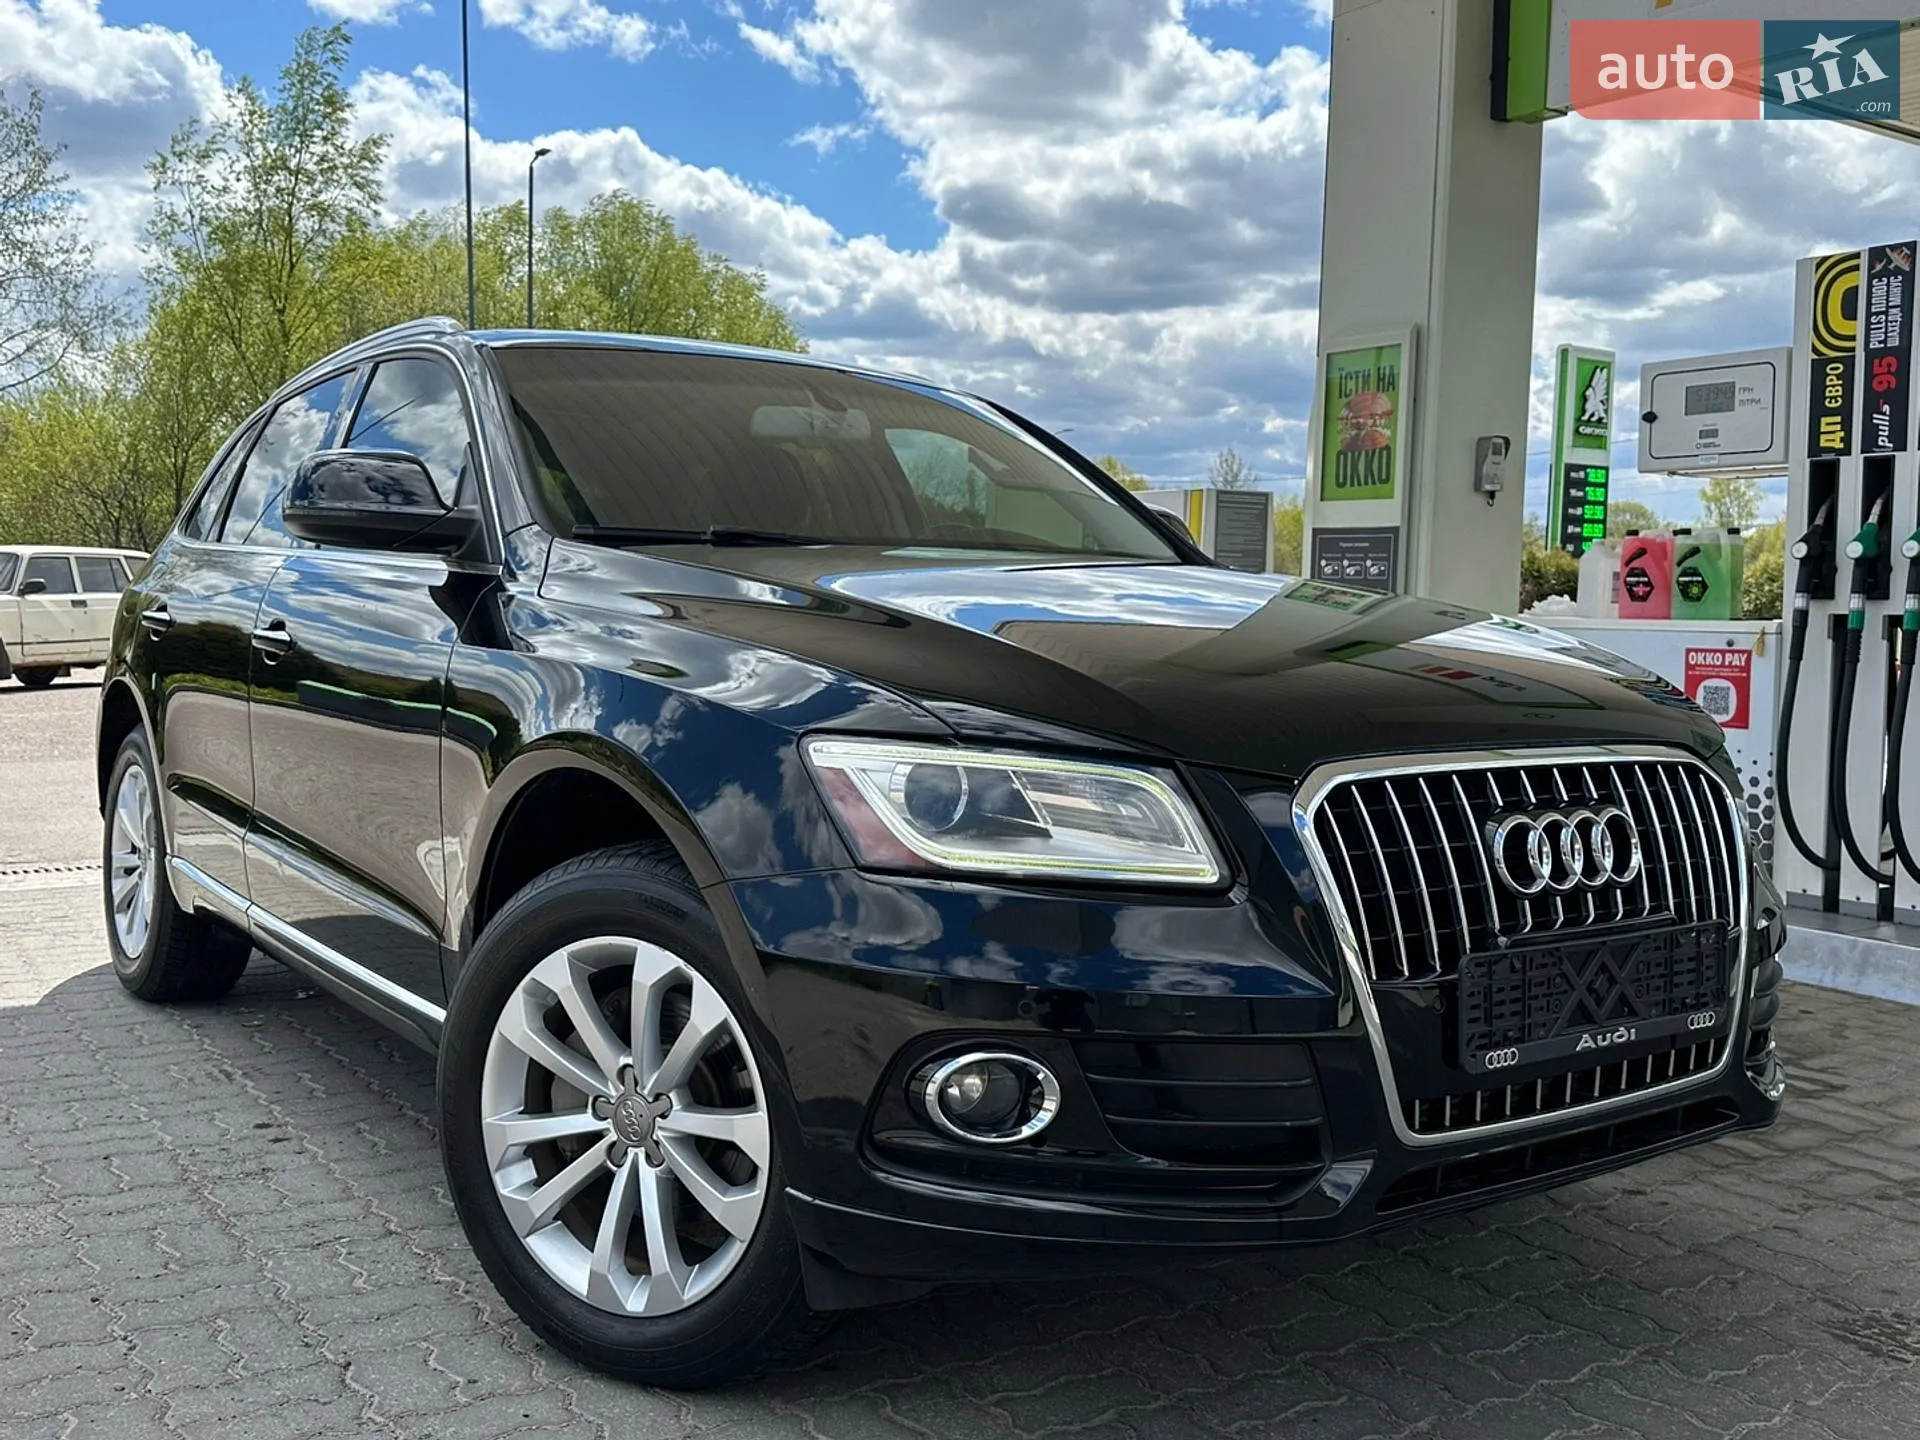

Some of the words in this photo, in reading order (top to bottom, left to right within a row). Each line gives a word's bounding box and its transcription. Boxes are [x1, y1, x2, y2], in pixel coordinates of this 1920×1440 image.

[1871, 277, 1888, 313] ПЛЮС
[1870, 315, 1886, 349] PULLS
[1338, 367, 1371, 399] ЇСТИ
[1376, 364, 1396, 393] НА
[1825, 362, 1844, 408] ЄВРО
[1872, 356, 1898, 392] 95
[1819, 415, 1844, 449] ДП
[1688, 651, 1723, 665] OKKO
[1724, 653, 1748, 666] PAY
[1576, 1027, 1636, 1051] Audi
